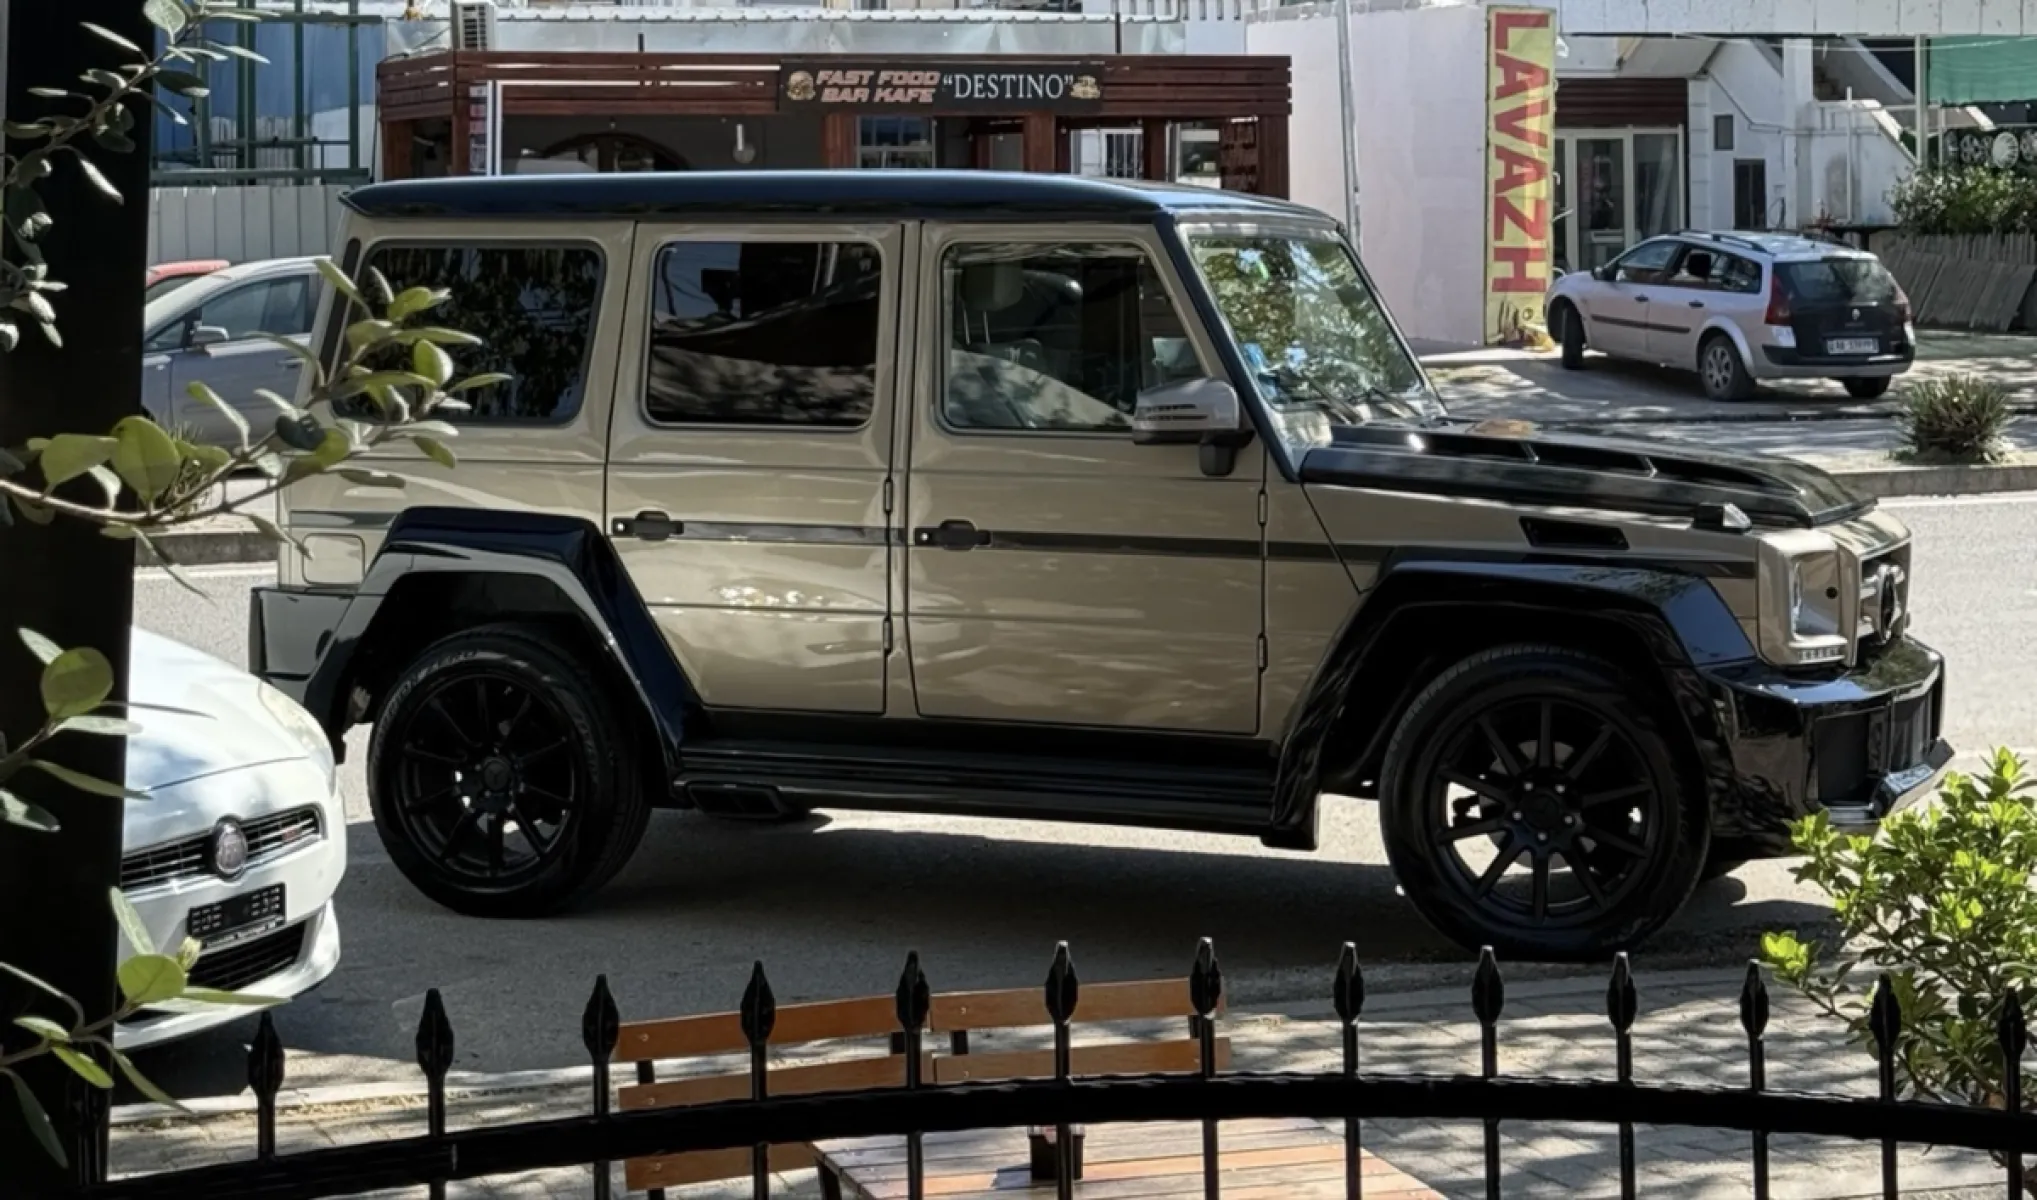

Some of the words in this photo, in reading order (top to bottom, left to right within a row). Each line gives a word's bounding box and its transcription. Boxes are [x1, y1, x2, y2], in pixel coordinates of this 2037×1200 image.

[816, 70, 874, 85] FAST
[877, 70, 941, 85] FOOD
[943, 73, 1074, 99] “DESTINO”
[821, 87, 870, 103] BAR
[873, 87, 936, 103] KAFE
[1491, 12, 1549, 293] LAVAZH
